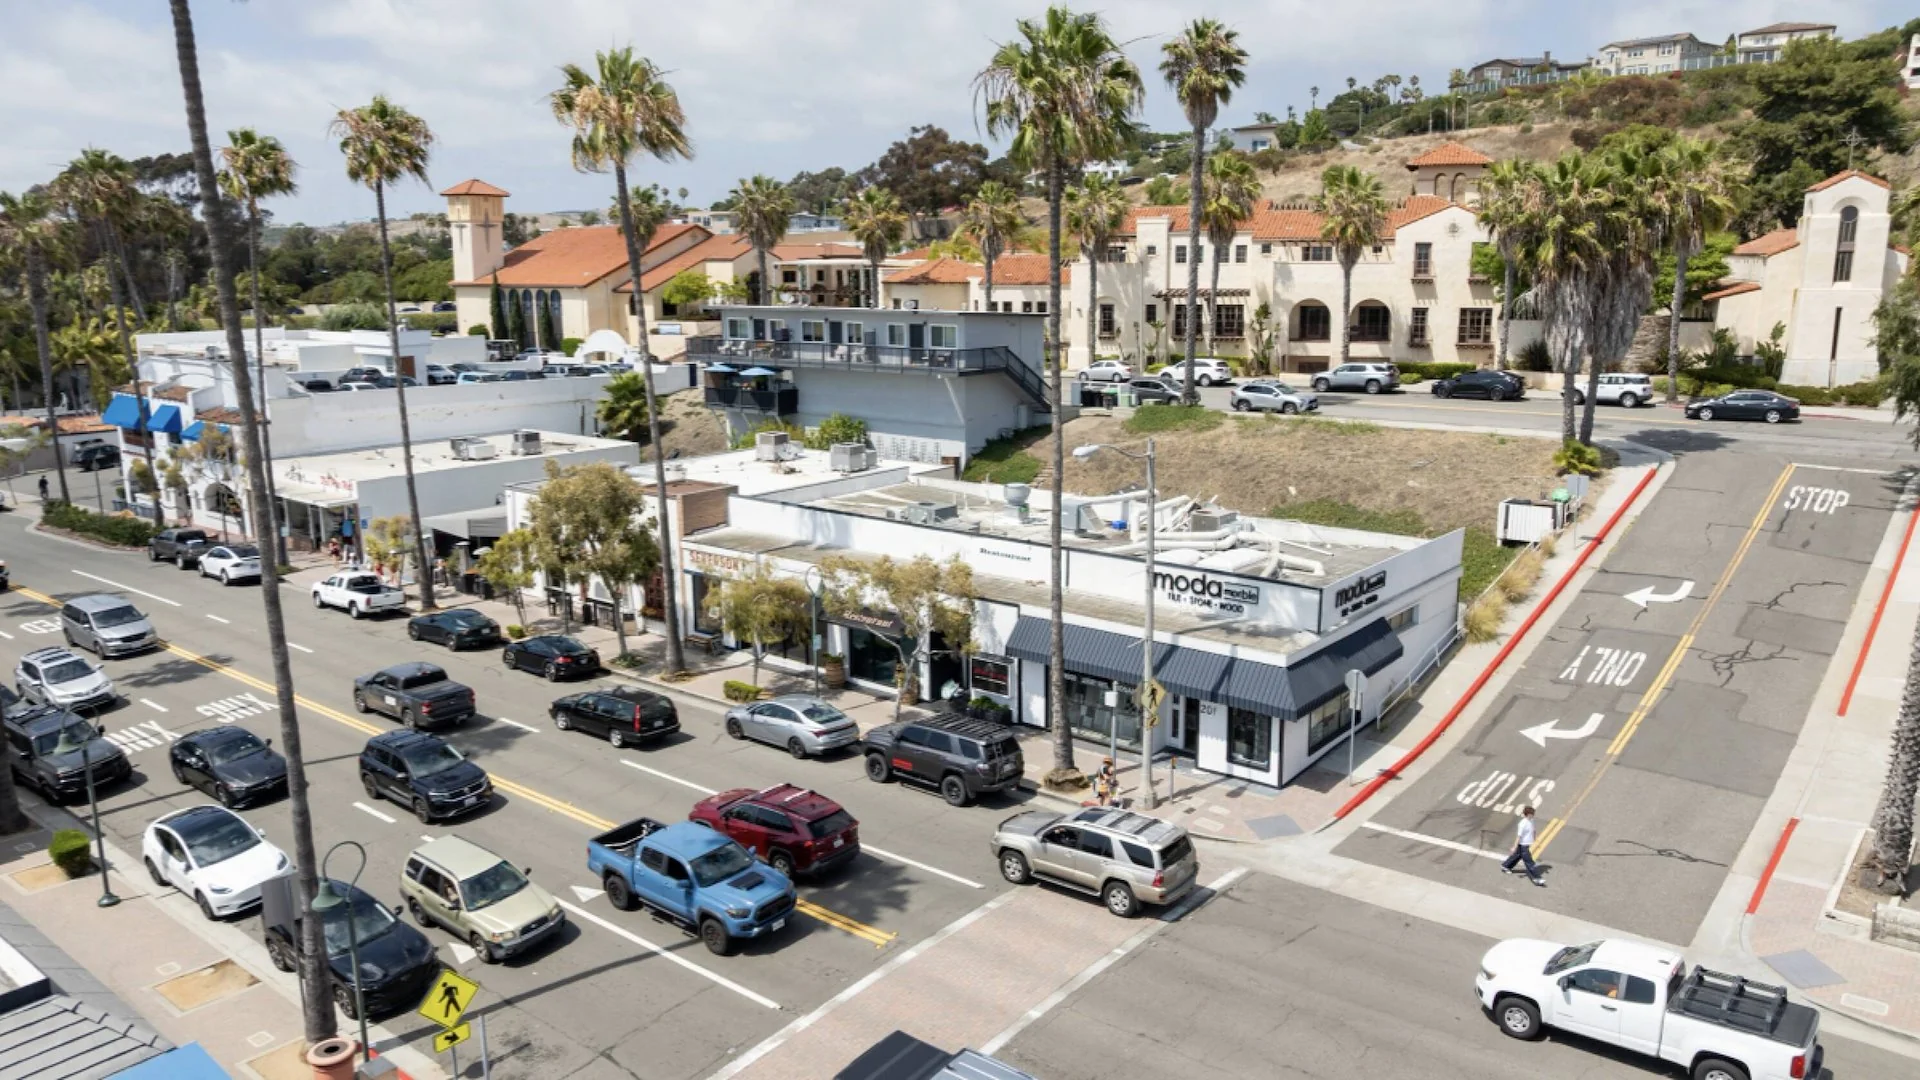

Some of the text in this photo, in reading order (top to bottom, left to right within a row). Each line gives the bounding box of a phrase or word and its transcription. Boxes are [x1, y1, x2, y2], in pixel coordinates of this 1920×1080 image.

[1784, 485, 1850, 515] STOP
[1153, 571, 1222, 597] moda
[1220, 601, 1244, 613] WOOD
[20, 617, 62, 633] ED
[1559, 645, 1647, 687] ONLY
[196, 692, 280, 723] XING
[1456, 770, 1555, 816] STOP
